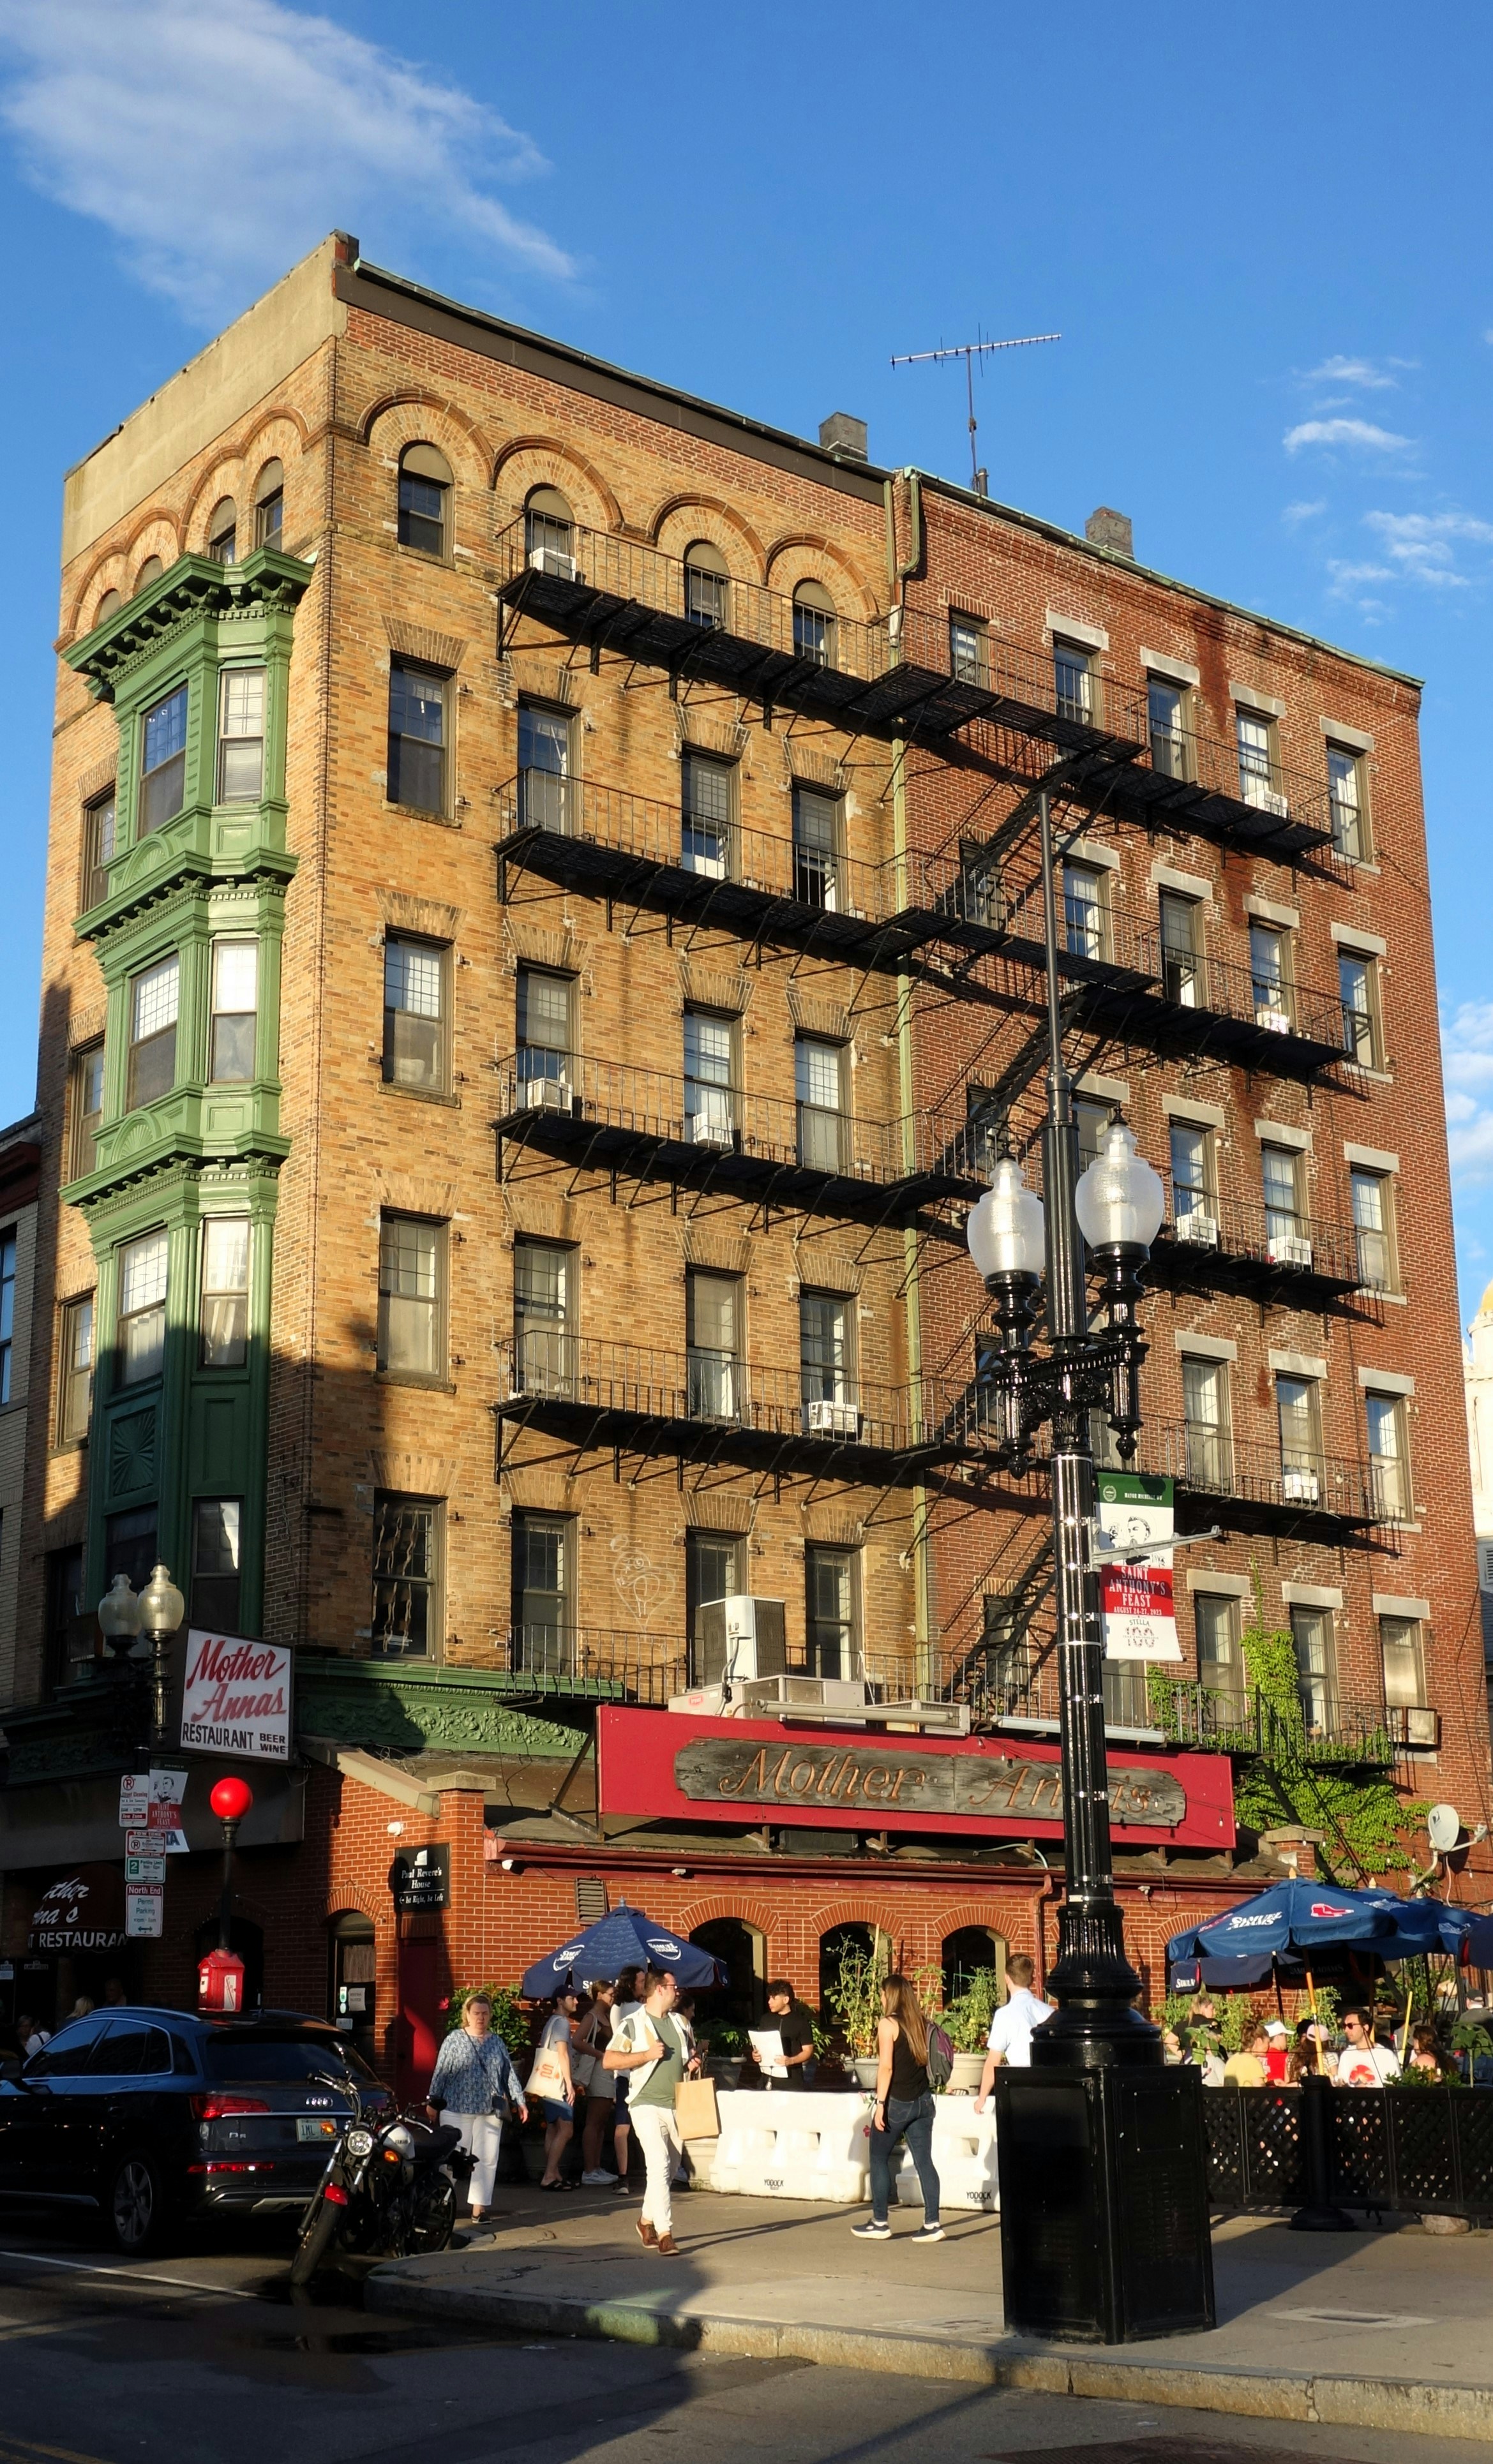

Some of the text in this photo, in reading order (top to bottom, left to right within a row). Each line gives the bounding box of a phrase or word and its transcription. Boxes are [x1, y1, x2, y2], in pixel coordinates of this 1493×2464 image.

[1121, 1566, 1149, 1579] SAINT
[1109, 1579, 1166, 1595] ANTHONY'S
[1122, 1594, 1151, 1608] FEAST
[1114, 1606, 1132, 1615] AUGUST
[185, 1639, 287, 1690] Mother
[191, 1683, 287, 1723] Annas
[182, 1722, 254, 1750] RESTAURANT
[259, 1733, 285, 1743] BEER
[259, 1743, 286, 1754] WINE
[718, 1747, 1151, 1813] Mother Ana's
[130, 1861, 138, 1870] 2
[401, 1866, 442, 1879] Paul Revere's
[128, 1886, 148, 1894] North
[411, 1879, 431, 1889] House
[434, 1893, 444, 1902] Left
[1229, 1911, 1282, 1925] SAMUEL
[40, 1932, 128, 1948] RESTAURAN
